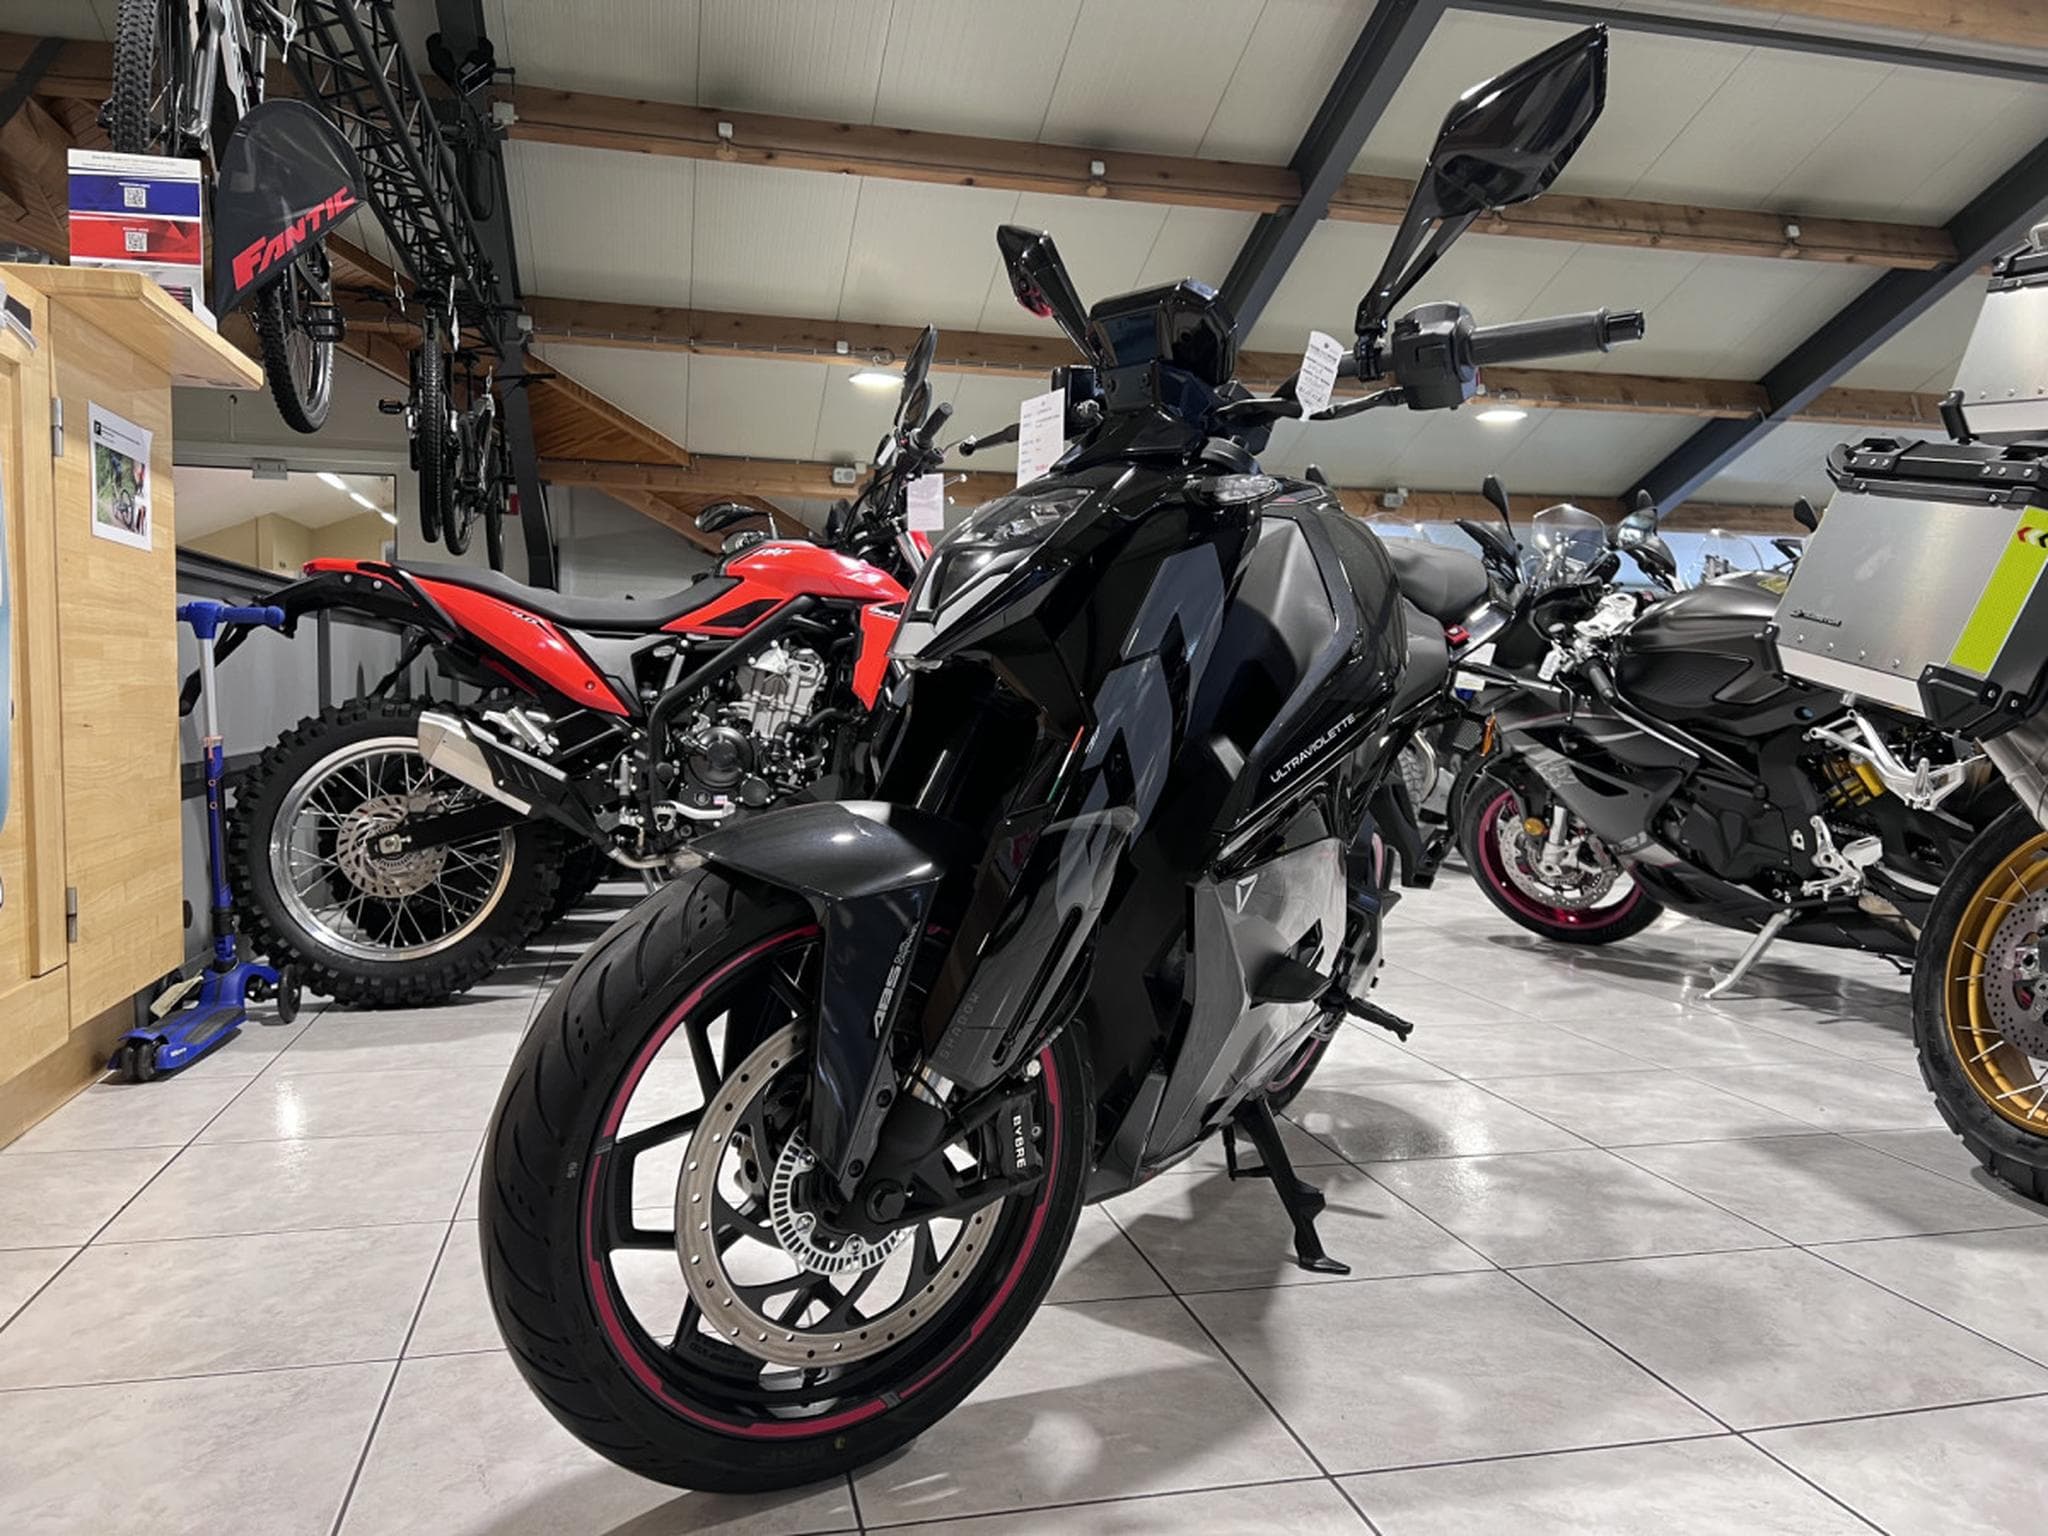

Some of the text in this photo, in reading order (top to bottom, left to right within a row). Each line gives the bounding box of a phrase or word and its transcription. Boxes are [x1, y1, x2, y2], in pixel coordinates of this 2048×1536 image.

[232, 186, 356, 291] FANTIC
[1270, 712, 1356, 783] ULTRAVIOLETTE
[874, 964, 902, 1039] ABS
[1012, 1115, 1027, 1169] BYBRE
